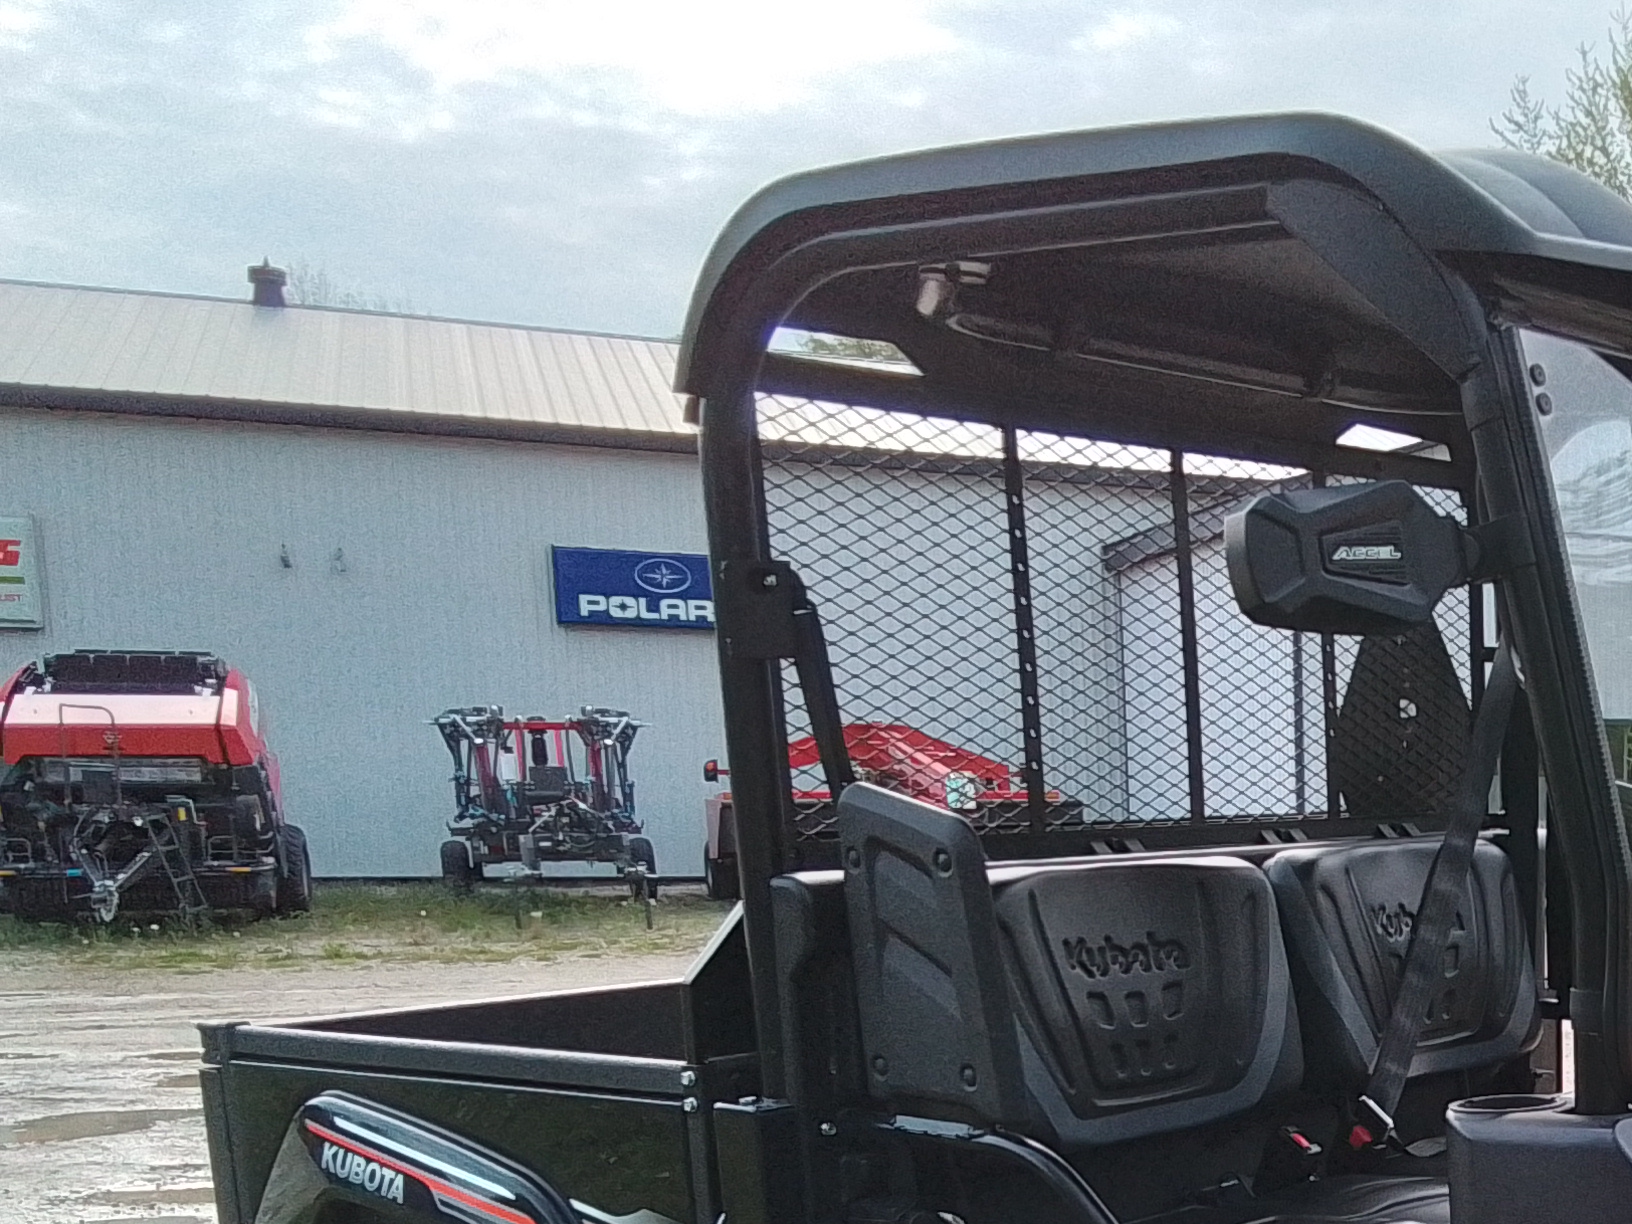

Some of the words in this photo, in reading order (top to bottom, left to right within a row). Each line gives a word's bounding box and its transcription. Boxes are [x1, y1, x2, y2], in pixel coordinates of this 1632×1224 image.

[578, 593, 716, 622] POLAR
[1062, 931, 1192, 981] Kubota
[321, 1141, 404, 1204] KUBOTA
